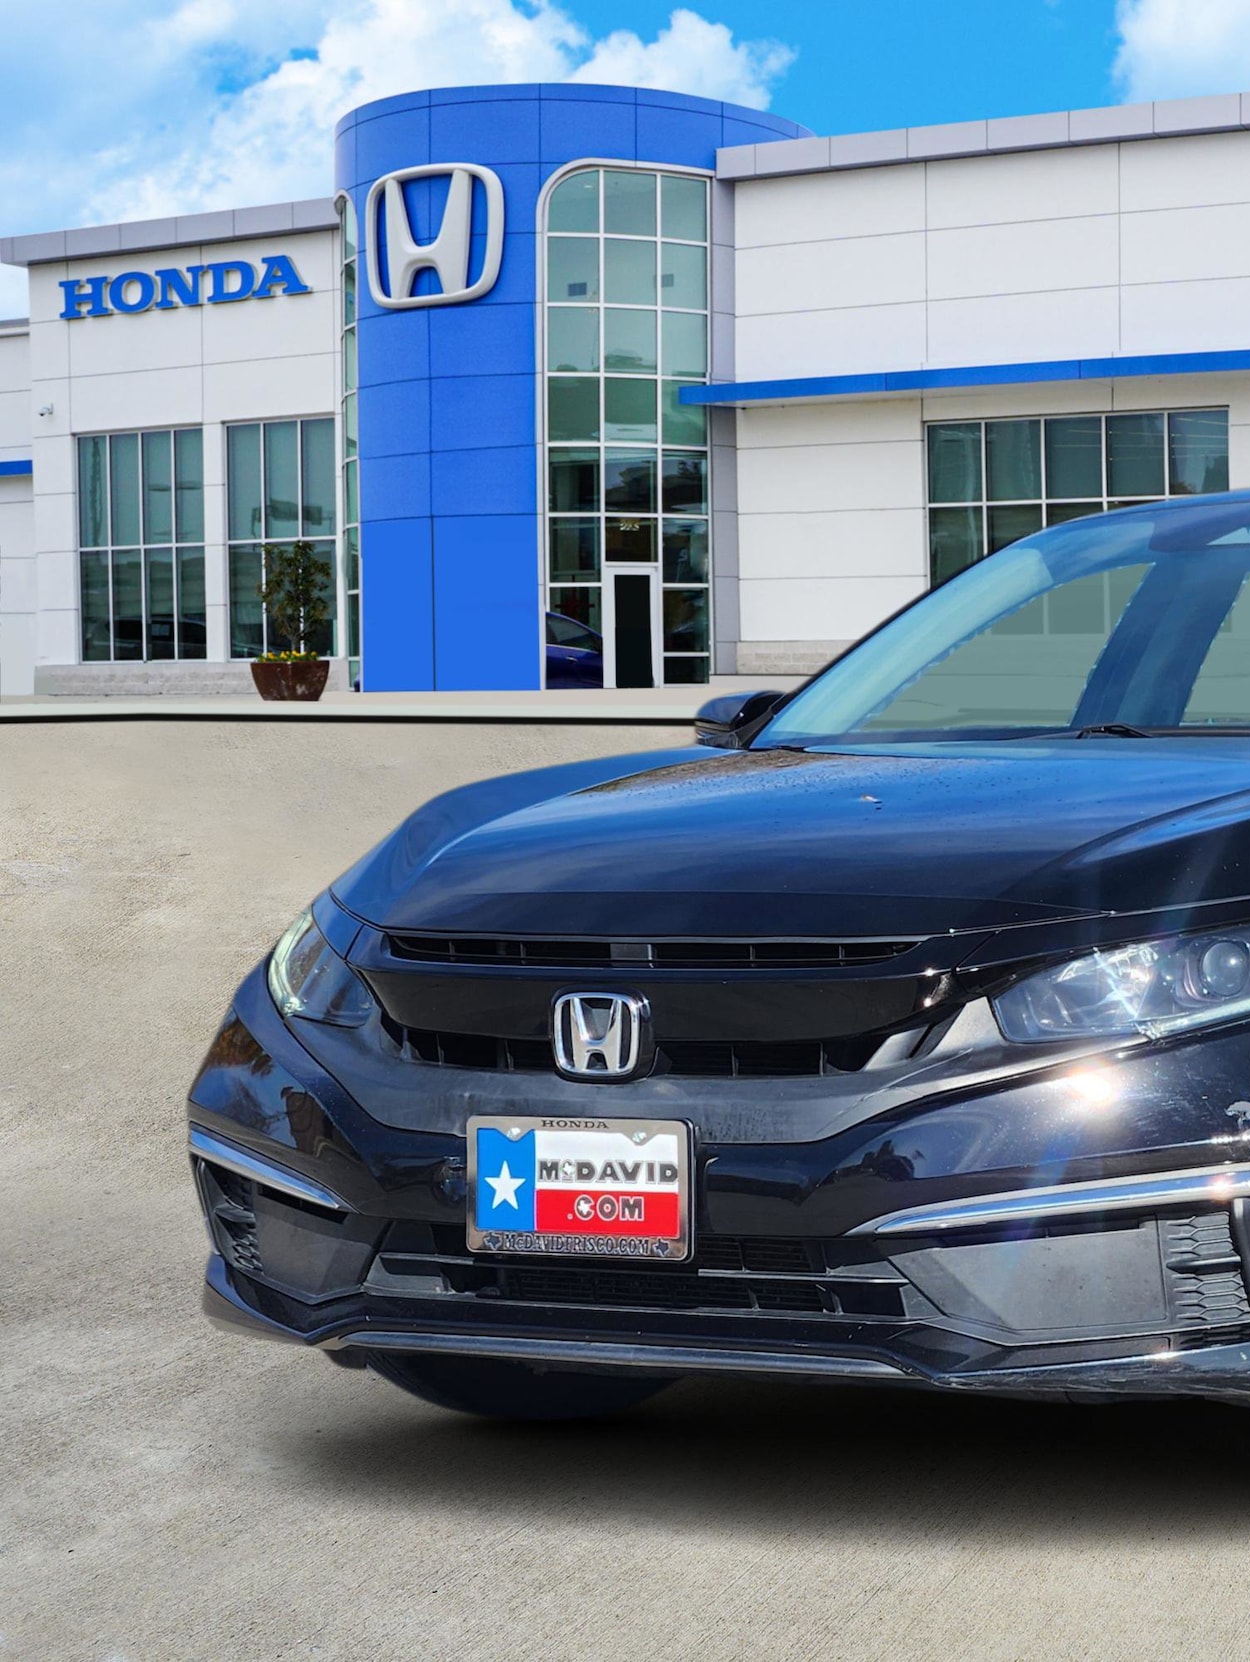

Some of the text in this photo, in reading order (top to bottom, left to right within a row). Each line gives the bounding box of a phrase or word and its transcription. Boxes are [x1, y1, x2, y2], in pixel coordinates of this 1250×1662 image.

[58, 254, 313, 320] HONDA
[541, 1119, 609, 1129] HONDA
[567, 1194, 645, 1222] .COM
